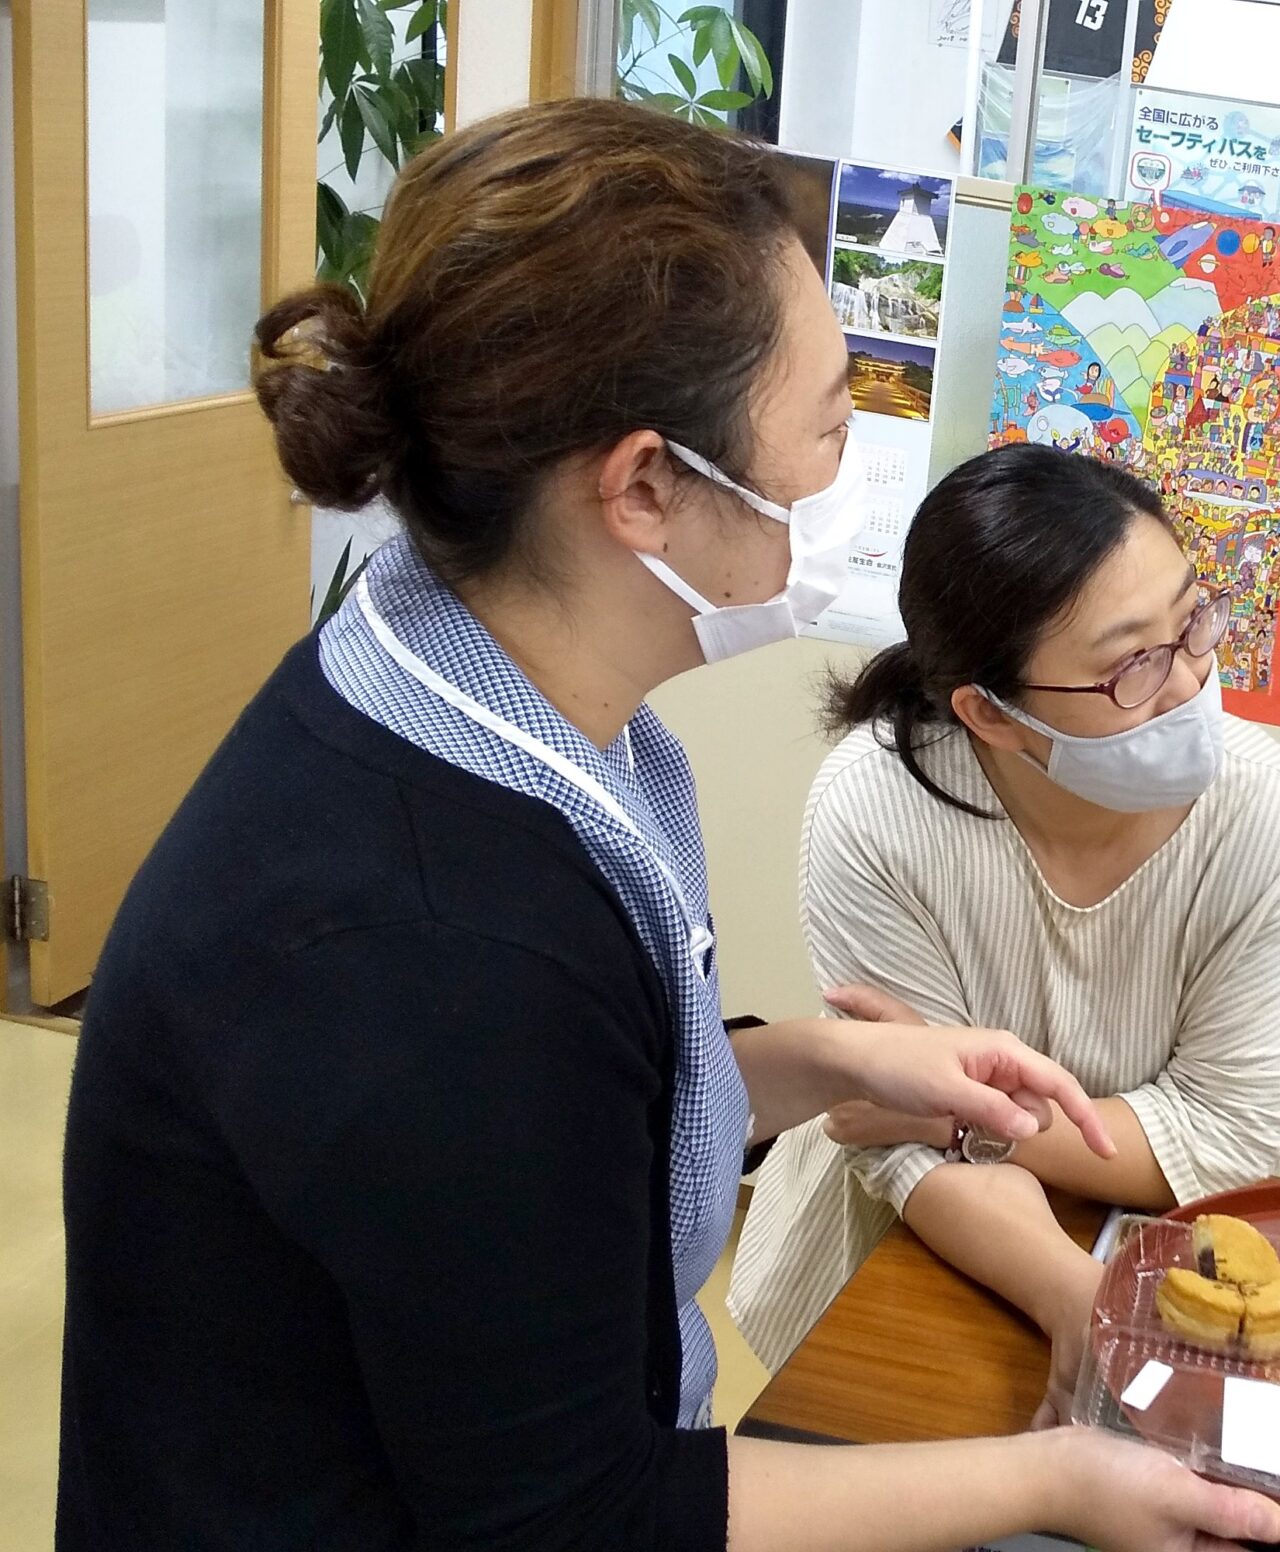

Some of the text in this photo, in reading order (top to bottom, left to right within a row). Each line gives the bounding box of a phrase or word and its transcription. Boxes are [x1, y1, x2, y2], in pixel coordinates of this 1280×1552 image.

[1075, 0, 1109, 31] 13
[1138, 106, 1220, 131] 全国に広がる
[1136, 125, 1269, 161] セーフティバスを
